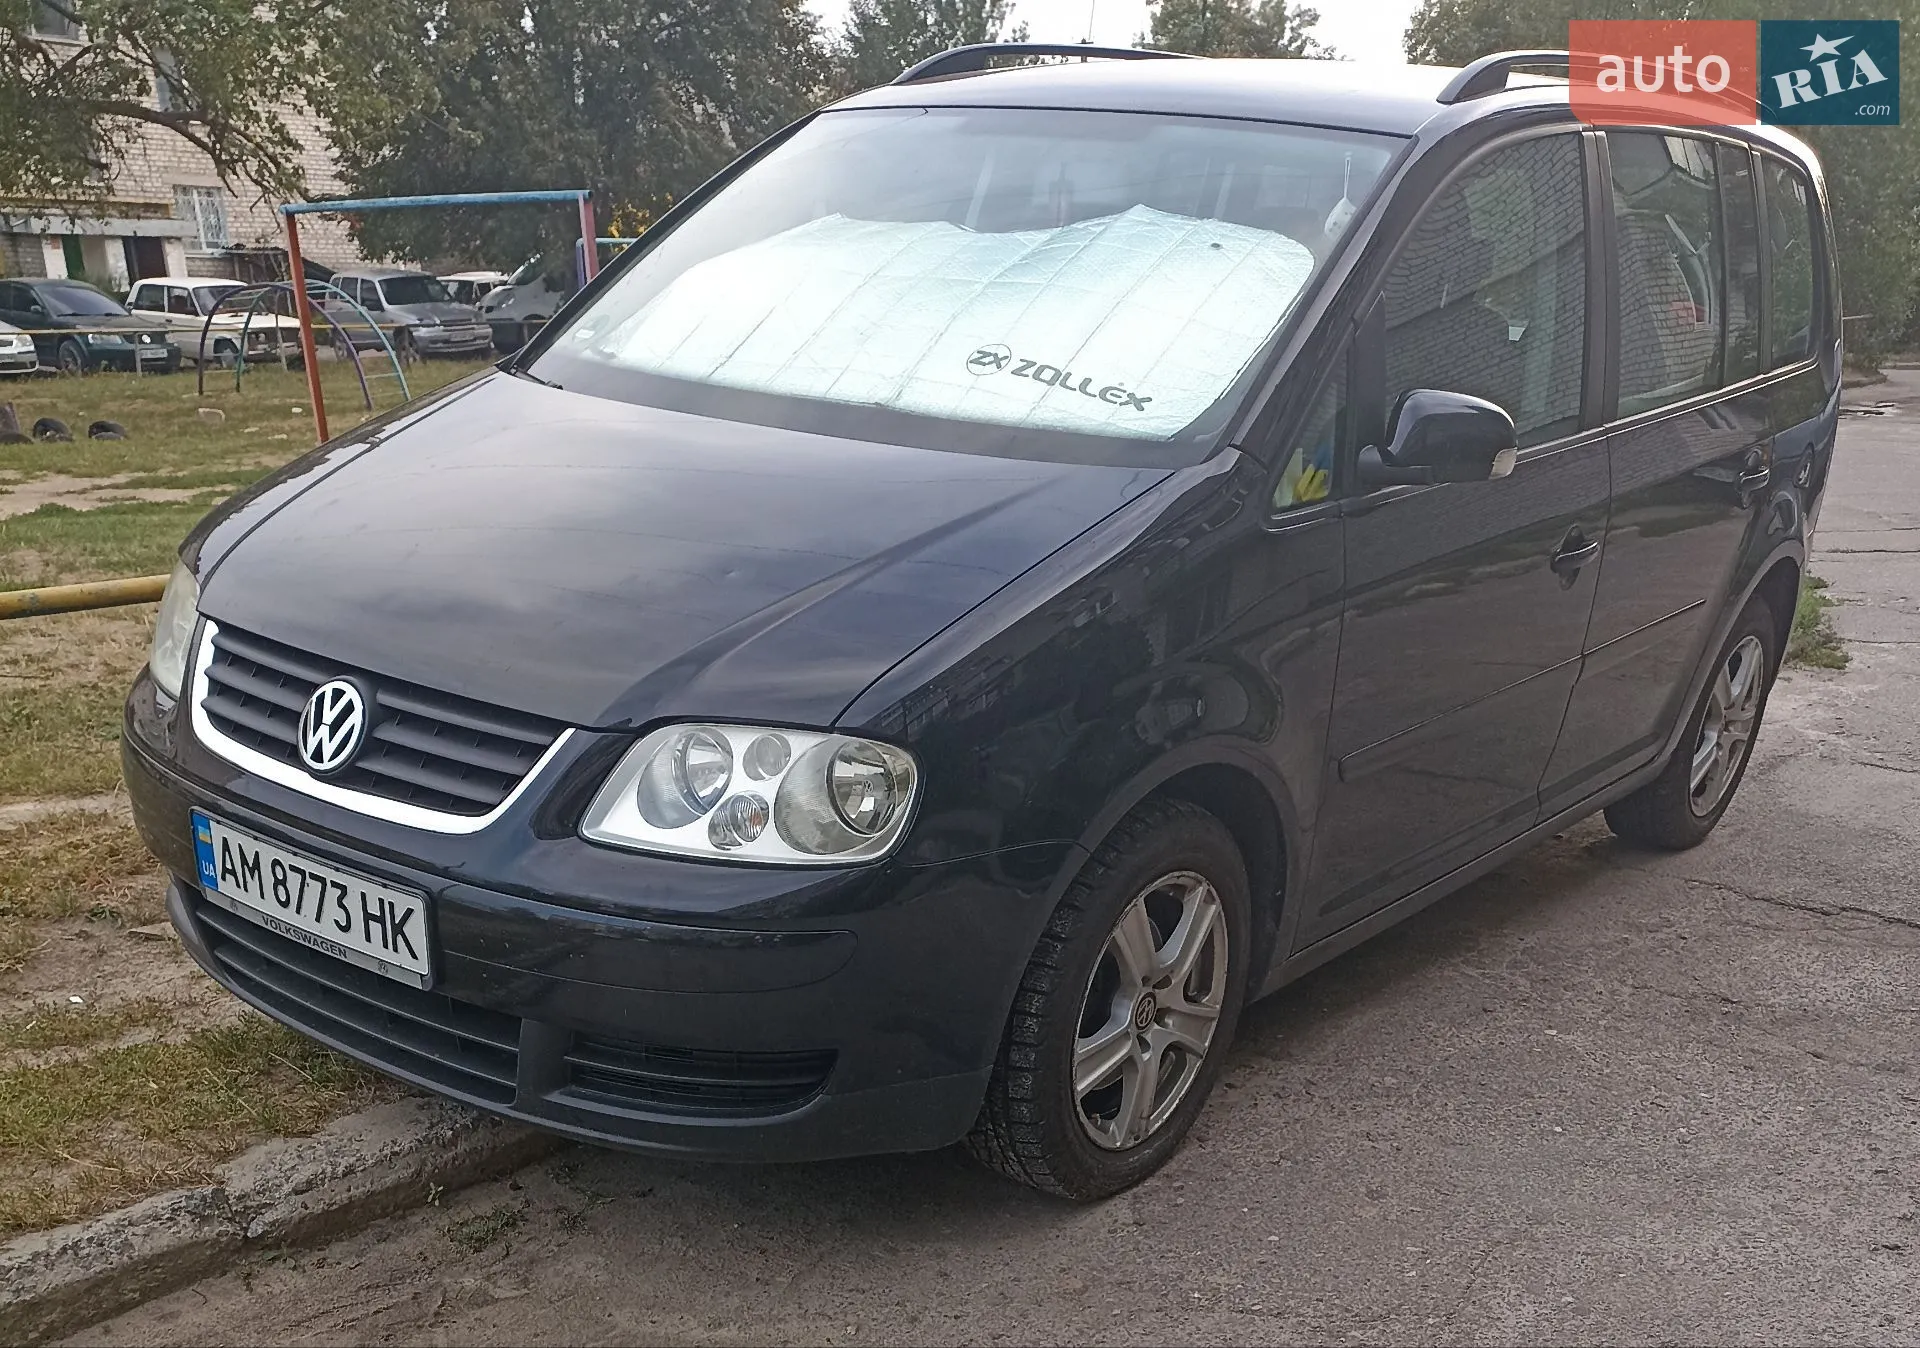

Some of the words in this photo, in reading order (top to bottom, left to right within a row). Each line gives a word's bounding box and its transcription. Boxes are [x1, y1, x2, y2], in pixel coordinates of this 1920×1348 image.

[1010, 358, 1153, 412] ZOLLEX
[302, 683, 361, 767] VW
[202, 862, 216, 879] UA
[220, 836, 265, 900] AM
[270, 857, 352, 933] 8773
[360, 889, 419, 961] HK
[261, 915, 348, 960] VOLKSWAGEN
